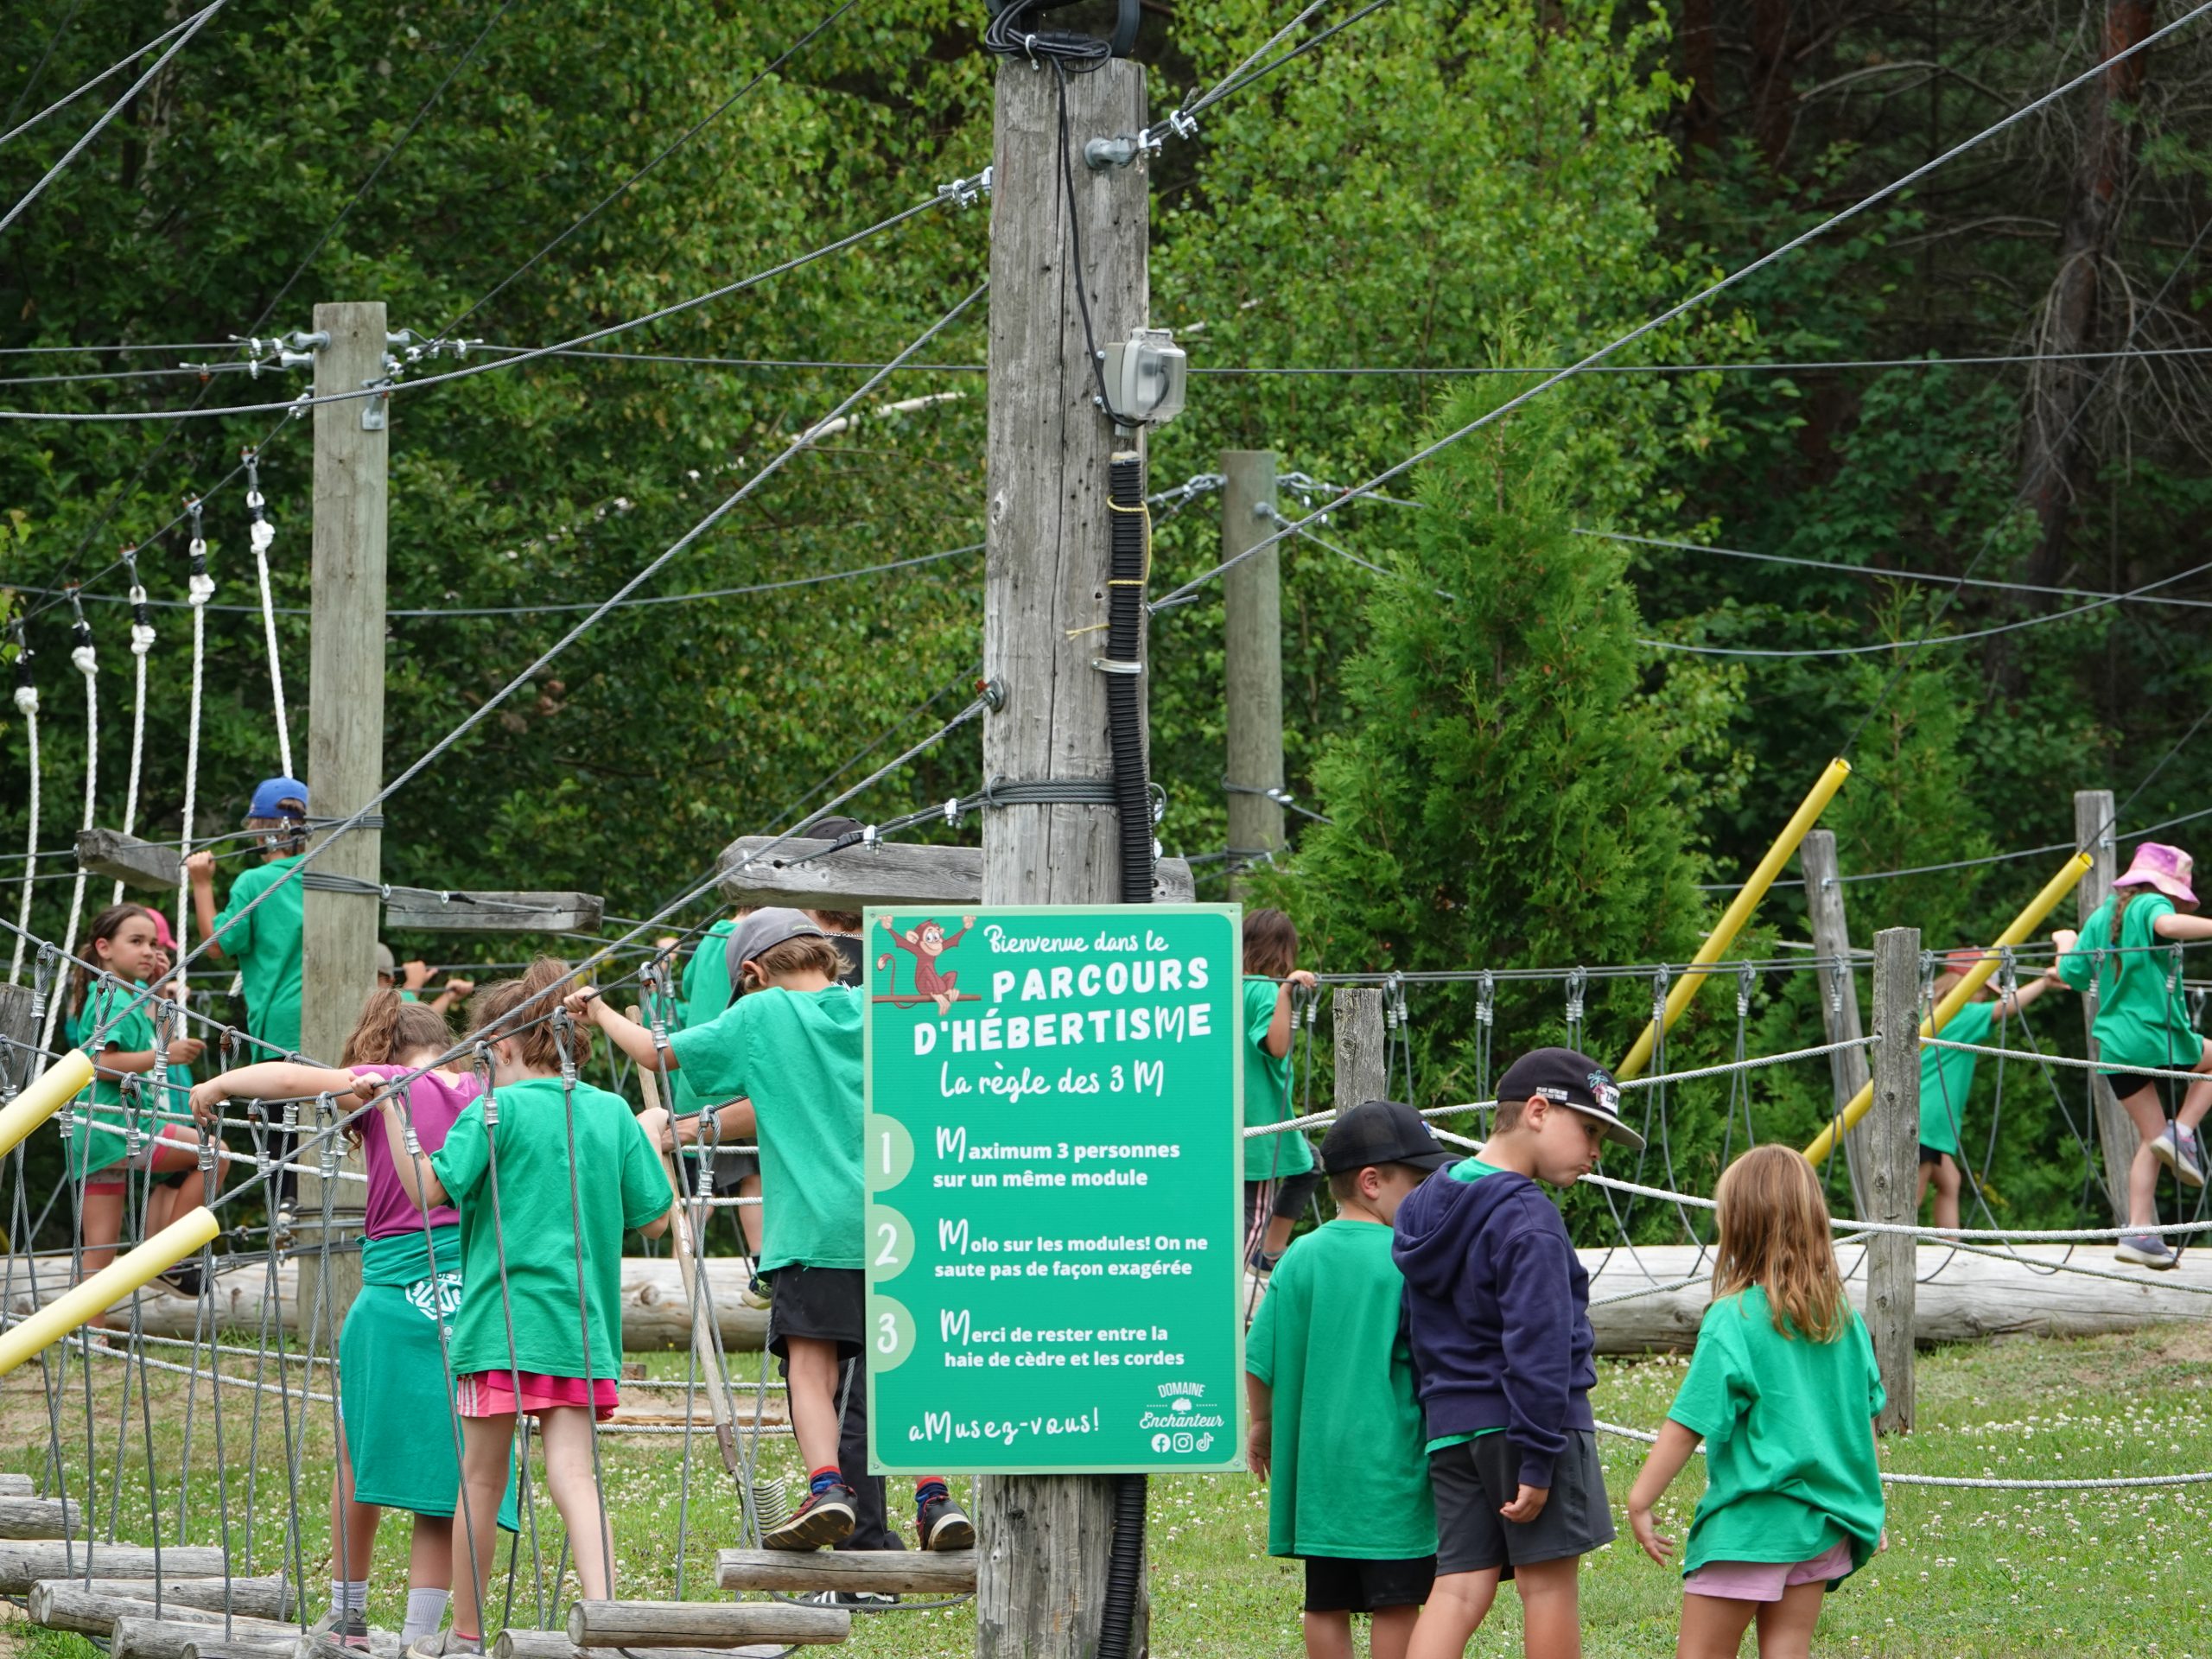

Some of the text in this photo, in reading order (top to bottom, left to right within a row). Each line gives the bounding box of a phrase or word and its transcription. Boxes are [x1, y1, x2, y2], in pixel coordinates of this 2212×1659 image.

[983, 925, 1169, 953] Bienvenue dans le
[993, 957, 1209, 1003] PARCOURS
[914, 1002, 1211, 1056] D'HÉBERTISME
[940, 1059, 1164, 1103] La règle des 3 M
[880, 1131, 890, 1174] 1
[936, 1126, 1180, 1163] Maximum 3 personnes
[933, 1169, 1148, 1188] sur un même module
[874, 1223, 899, 1267] 2
[938, 1217, 1208, 1255] Molo sur les modules! On ne
[935, 1259, 1192, 1281] saute pas de façon exagérée
[876, 1313, 899, 1354] 3
[940, 1308, 1168, 1346] Merci de rester entre la
[944, 1350, 1185, 1367] haie de cèdre et les cordes
[1157, 1382, 1205, 1398] DOMAINE
[1139, 1411, 1224, 1429] Enchanteur
